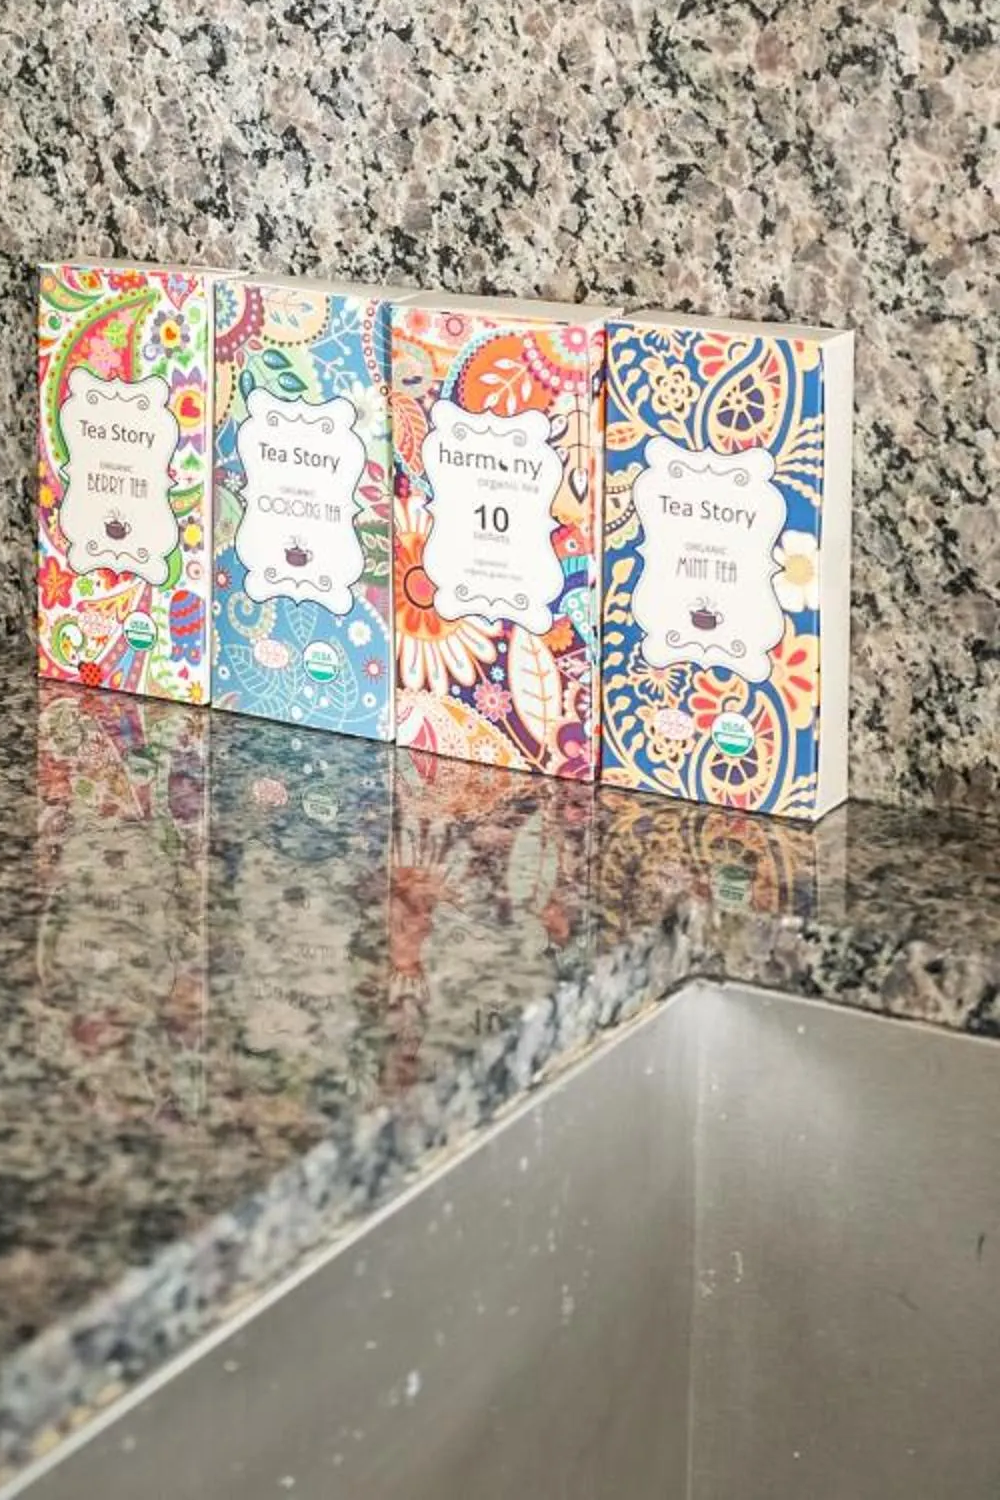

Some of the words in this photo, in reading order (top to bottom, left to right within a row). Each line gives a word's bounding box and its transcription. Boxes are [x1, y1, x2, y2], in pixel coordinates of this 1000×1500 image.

[79, 419, 107, 440] Tea
[111, 423, 156, 448] Story
[258, 442, 288, 463] Tea
[293, 447, 340, 473] Story
[87, 473, 127, 495] BERRY
[129, 477, 149, 499] TEA
[473, 504, 510, 533] 10
[658, 495, 693, 517] Tea
[700, 500, 757, 529] Story
[675, 557, 709, 580] MINT
[715, 559, 738, 584] TEA
